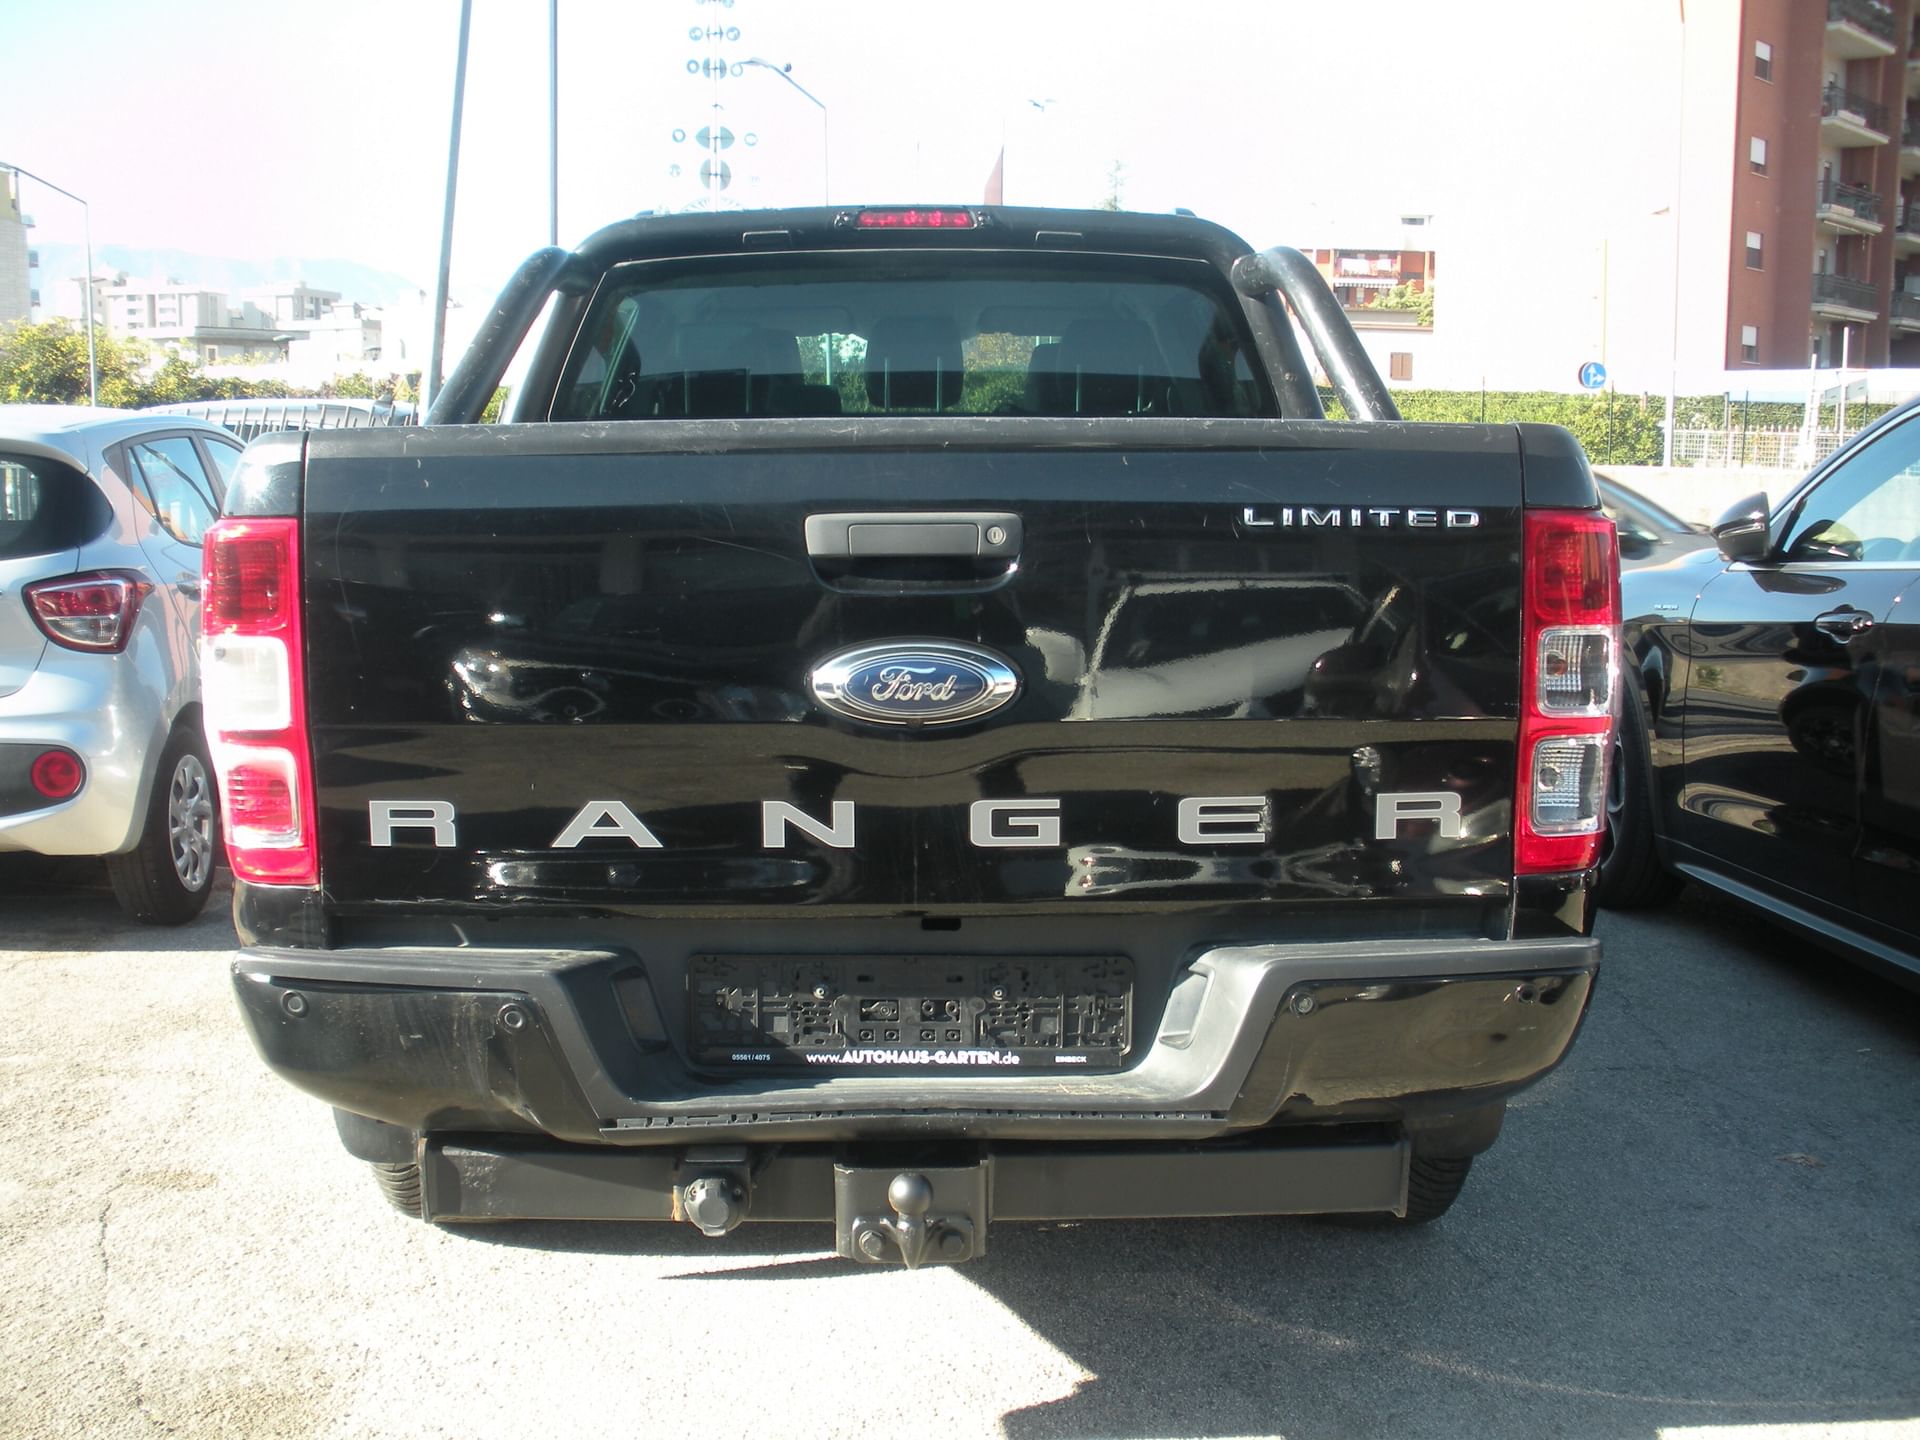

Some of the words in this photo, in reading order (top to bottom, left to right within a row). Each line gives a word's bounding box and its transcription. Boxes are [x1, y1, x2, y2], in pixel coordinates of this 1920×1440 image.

[1243, 508, 1481, 528] LIMITED
[871, 665, 958, 701] Ford
[368, 791, 1464, 850] RANGER
[806, 1050, 1020, 1065] www.AUTOHAUS-GARTEN.de
